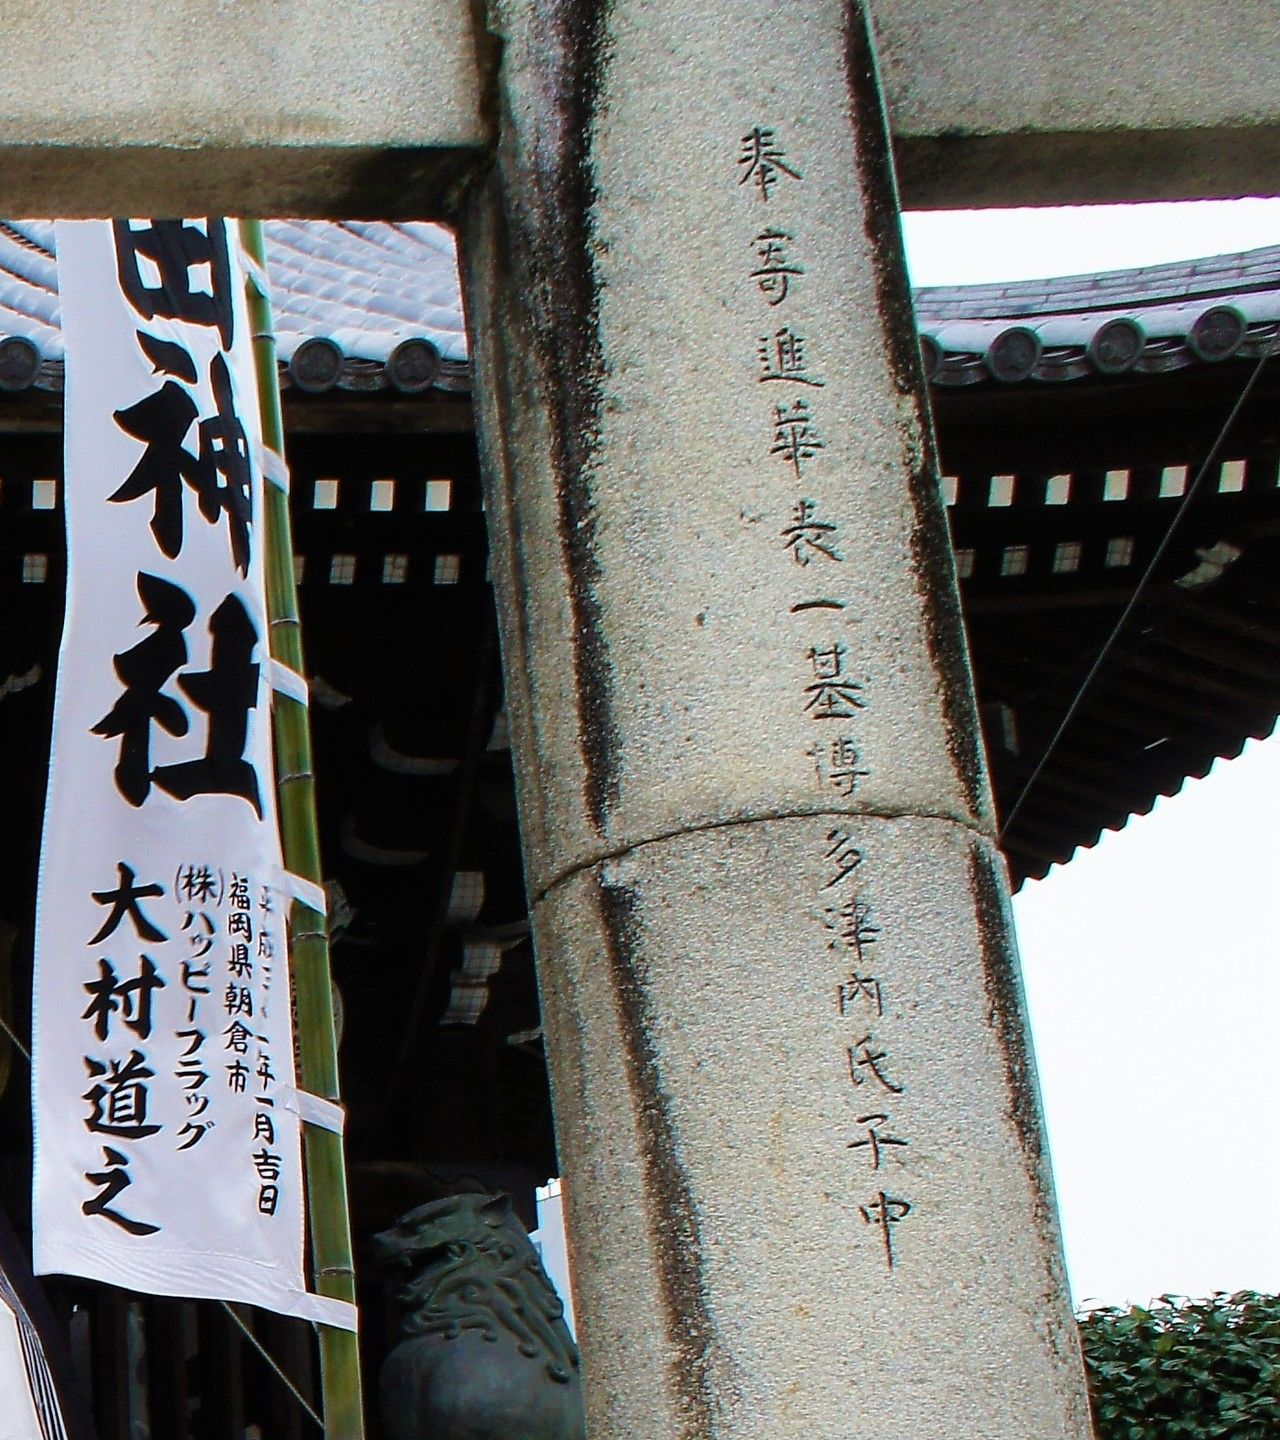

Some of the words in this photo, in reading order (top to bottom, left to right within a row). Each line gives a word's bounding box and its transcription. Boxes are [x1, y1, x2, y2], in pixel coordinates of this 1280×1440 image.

[81, 862, 169, 1236] 大村道之
[174, 863, 225, 1151] (株)ハッピーフラッグ
[222, 872, 253, 1093] 福岡県朝倉市
